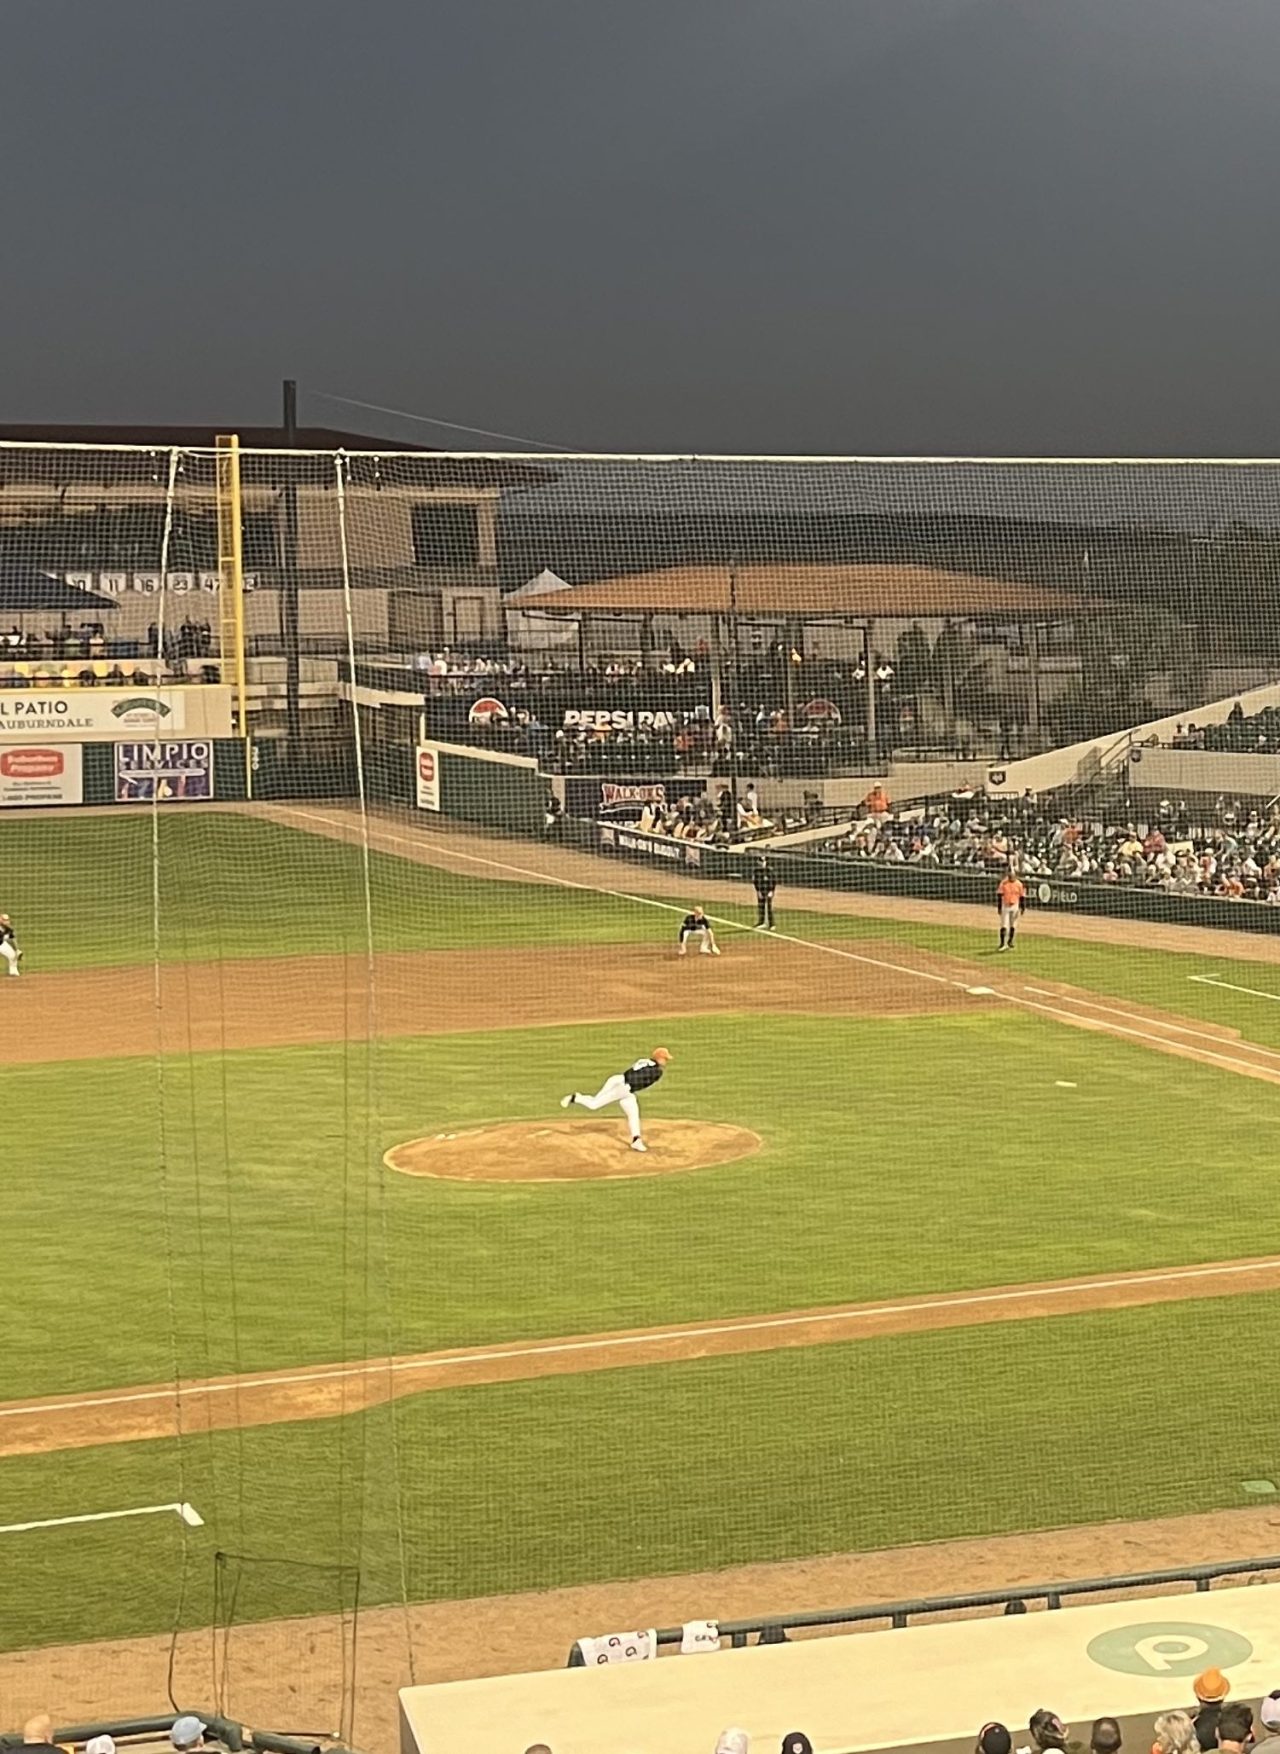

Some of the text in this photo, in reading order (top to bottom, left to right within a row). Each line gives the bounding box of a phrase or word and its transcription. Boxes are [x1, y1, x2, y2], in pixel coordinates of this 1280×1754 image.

[15, 701, 68, 715] PATIO
[563, 710, 634, 730] PEPSI
[119, 743, 209, 762] LIMPIO
